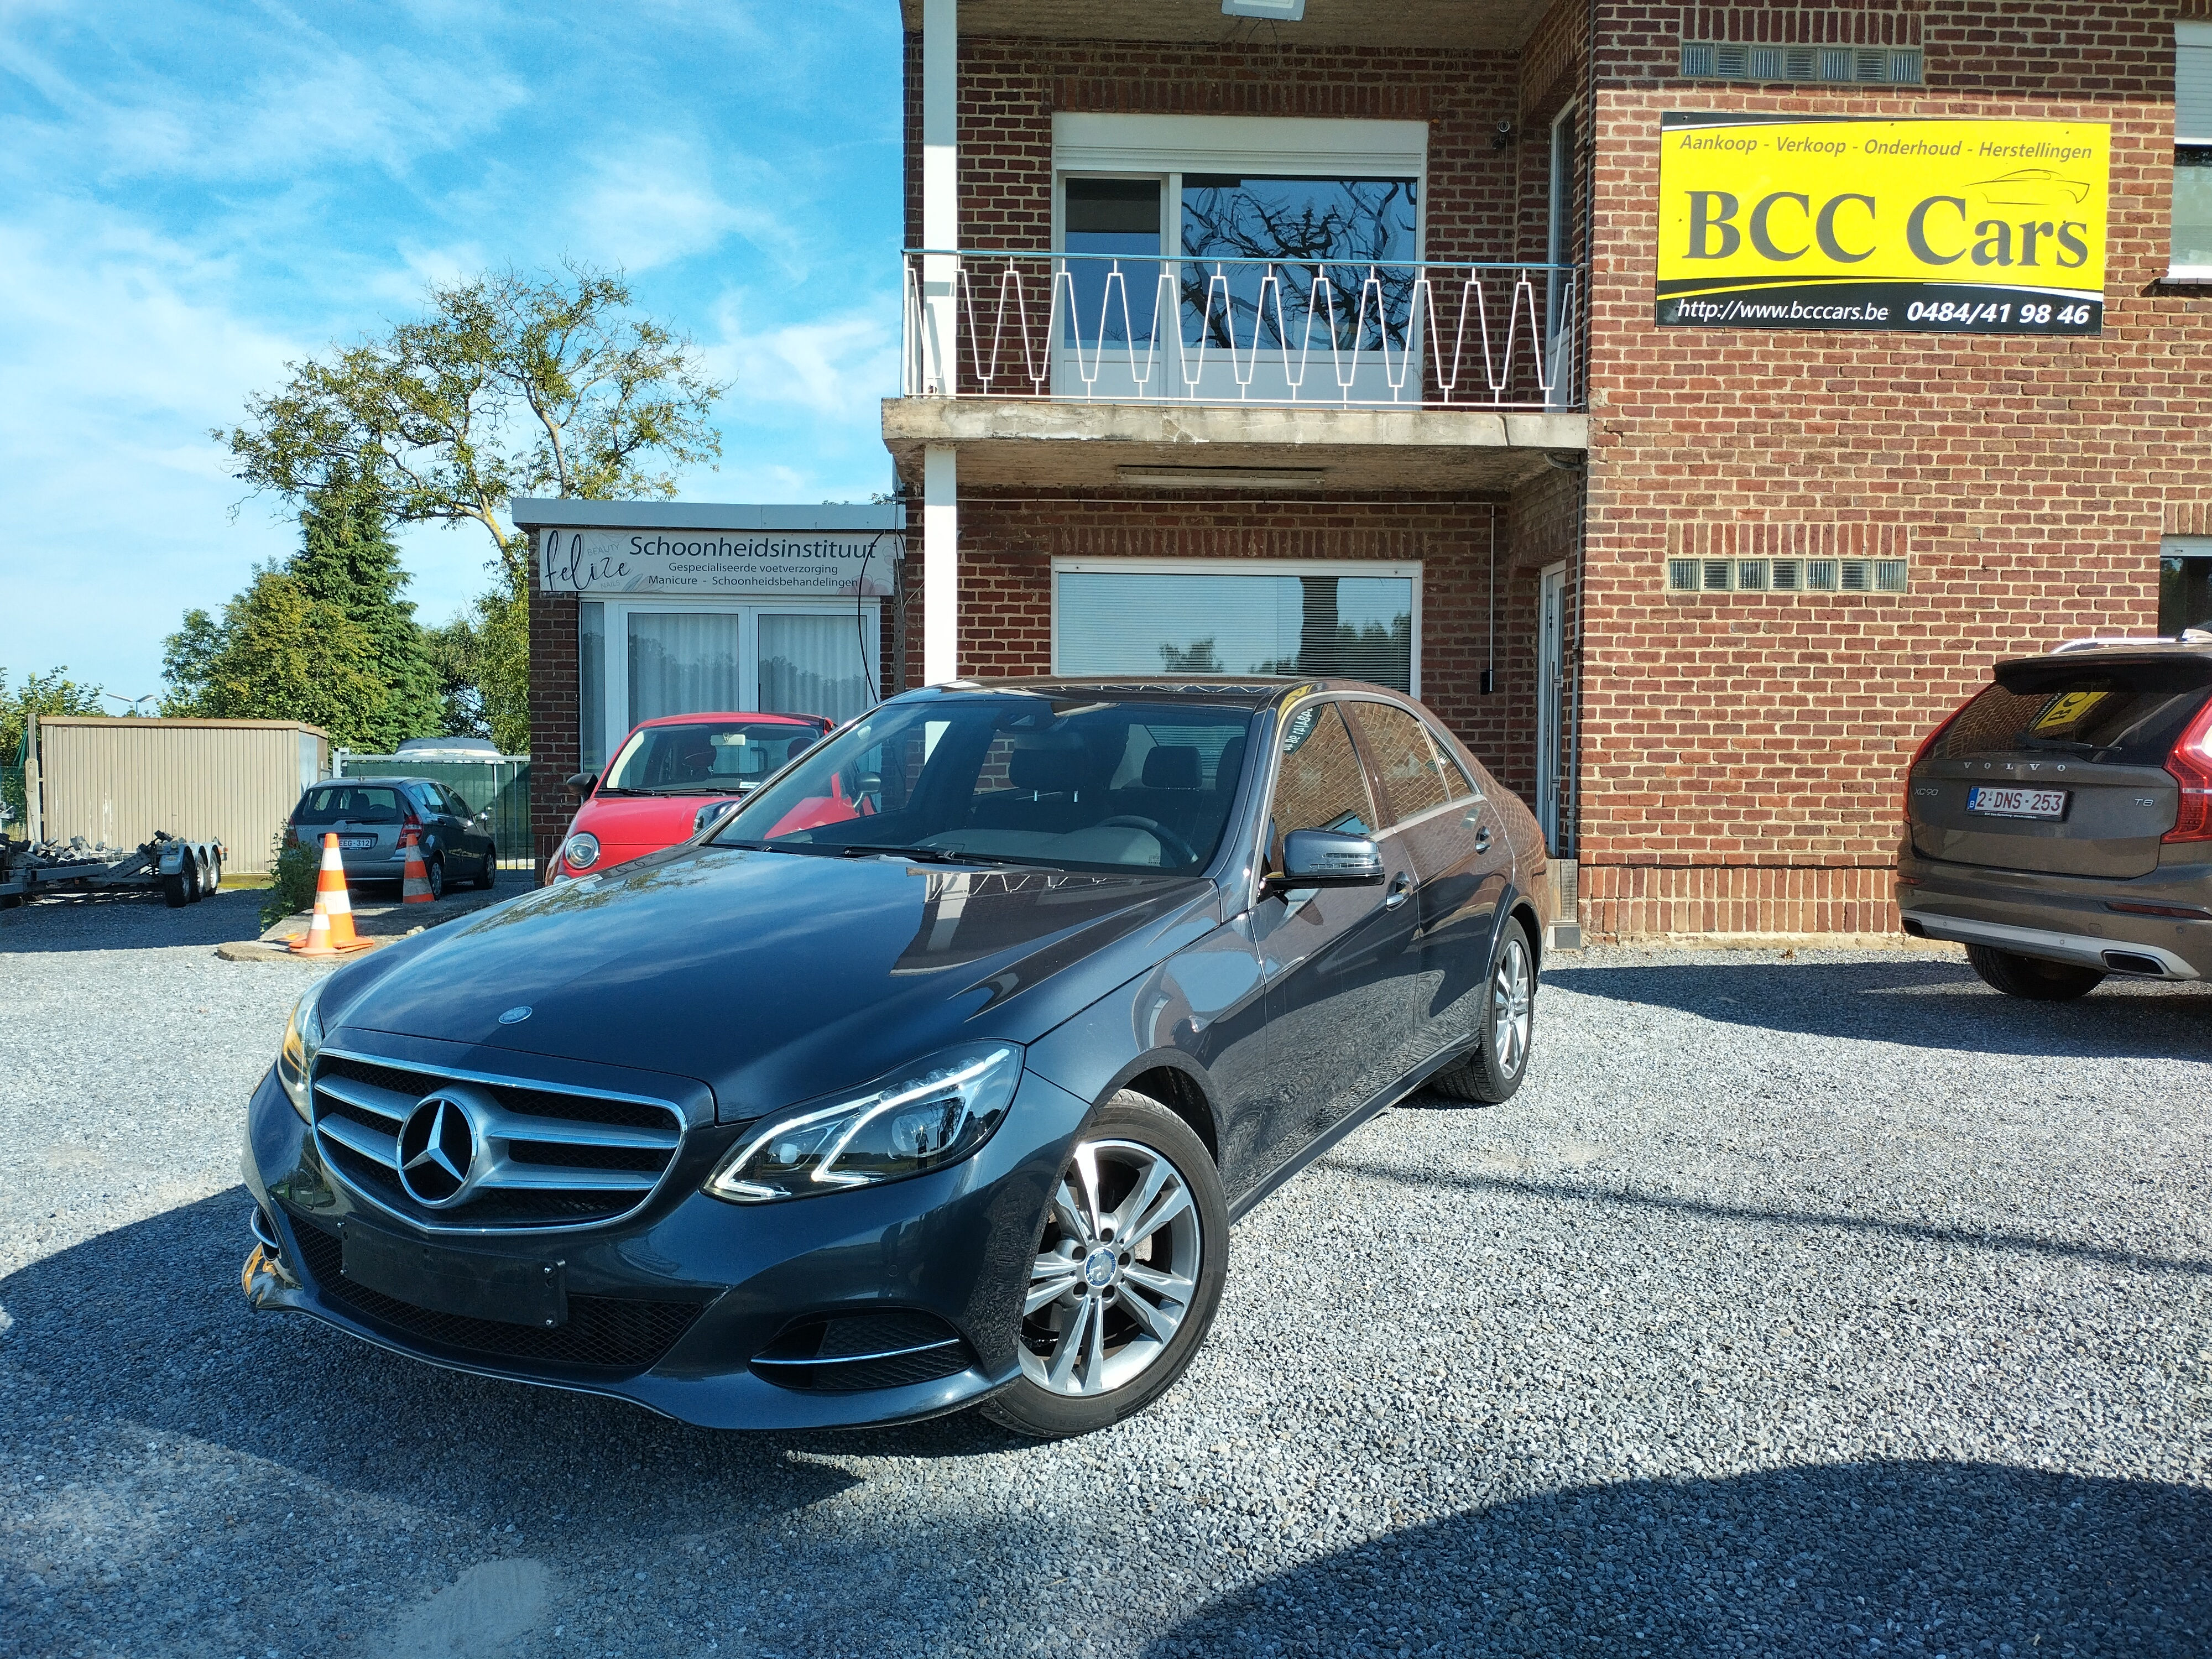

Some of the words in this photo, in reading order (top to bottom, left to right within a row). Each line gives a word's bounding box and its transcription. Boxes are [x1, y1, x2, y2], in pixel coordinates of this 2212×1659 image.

[1679, 134, 1757, 155] Aankoop
[1777, 137, 1846, 157] Verkoop
[1864, 139, 1963, 156] Onderhoud
[1978, 142, 2092, 163] Herstellingen
[1682, 190, 1877, 263] BCC
[1906, 195, 2088, 269] Cars
[1677, 299, 1888, 322] http://www.bcccars.be
[1907, 301, 2012, 325] 0484/41
[2019, 304, 2052, 324] 98
[2057, 305, 2090, 325] 46
[587, 543, 620, 556] BEAUTY
[629, 536, 877, 559] Schoonheidsinstituut
[669, 562, 757, 573] Gespecialiseerde
[760, 565, 838, 576] voetverzorging
[600, 580, 620, 589] NAILS
[649, 575, 698, 585] Manicure
[712, 576, 858, 589] Schoonheidsbehandelingen
[1963, 761, 2066, 772] VOLVO
